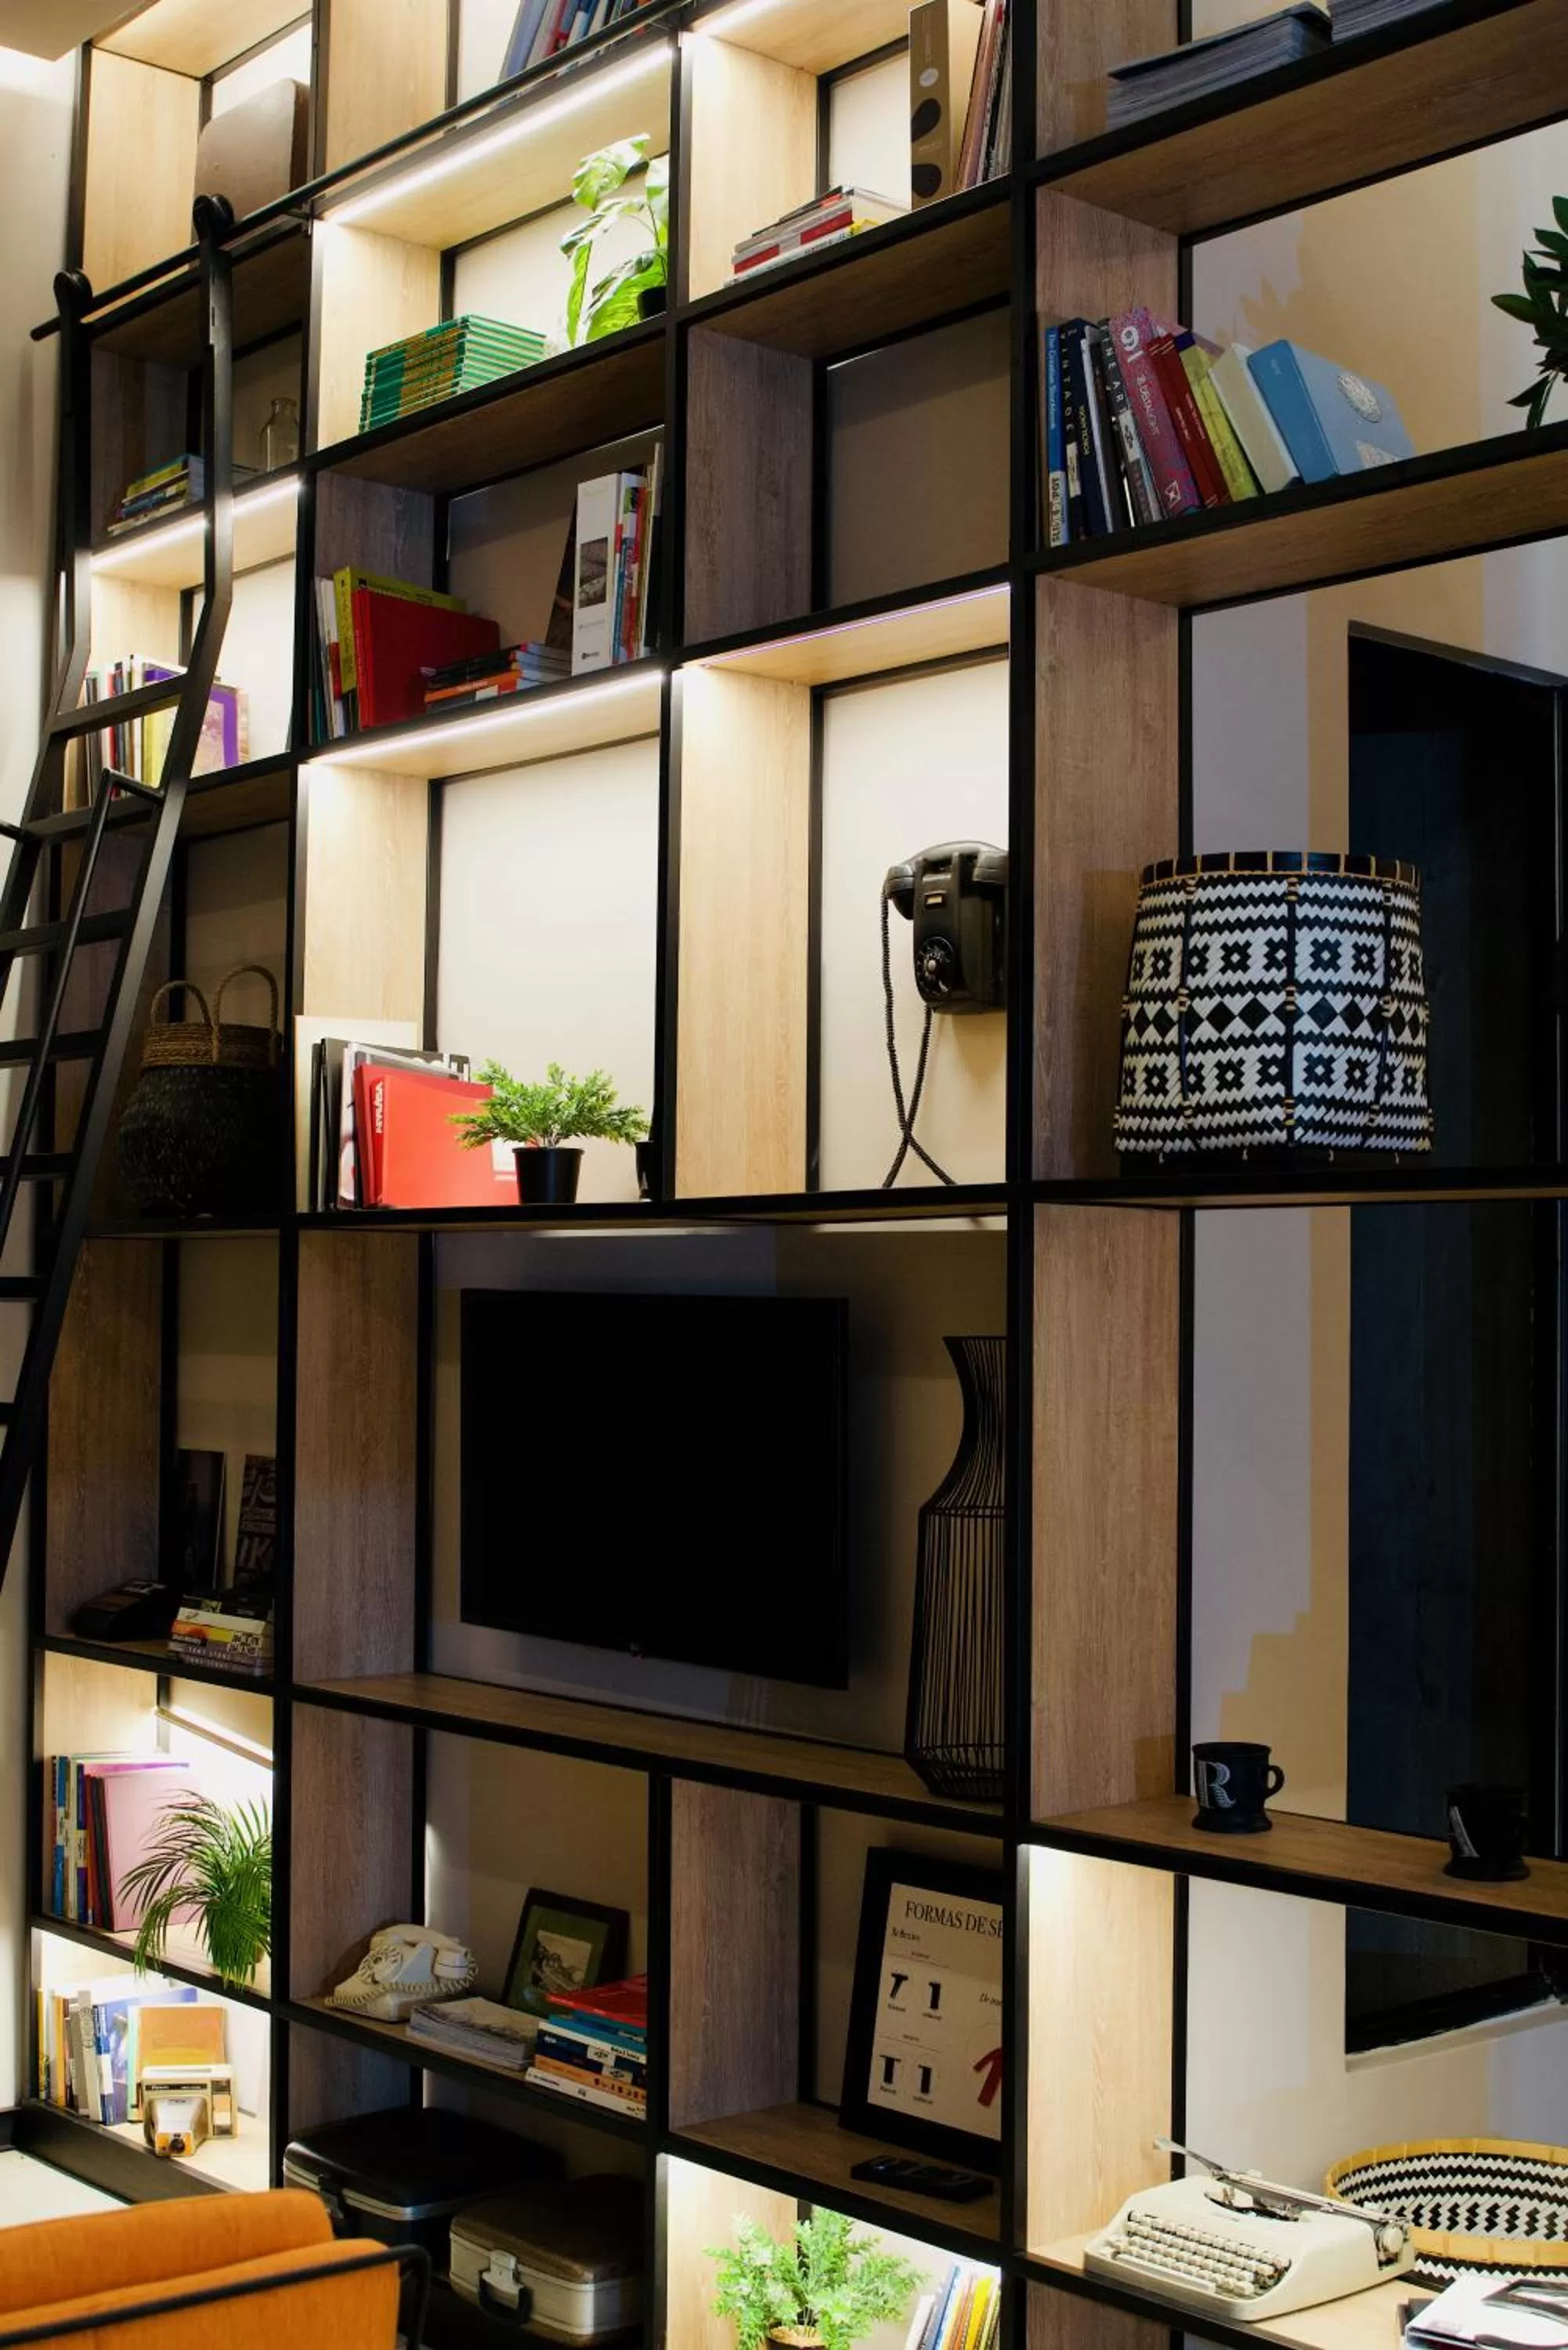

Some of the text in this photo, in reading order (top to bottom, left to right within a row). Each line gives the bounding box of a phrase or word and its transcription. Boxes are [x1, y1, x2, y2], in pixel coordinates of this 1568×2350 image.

[1197, 1759, 1237, 1809] R
[905, 1900, 963, 1929] FORMAS
[965, 1914, 988, 1934] DE
